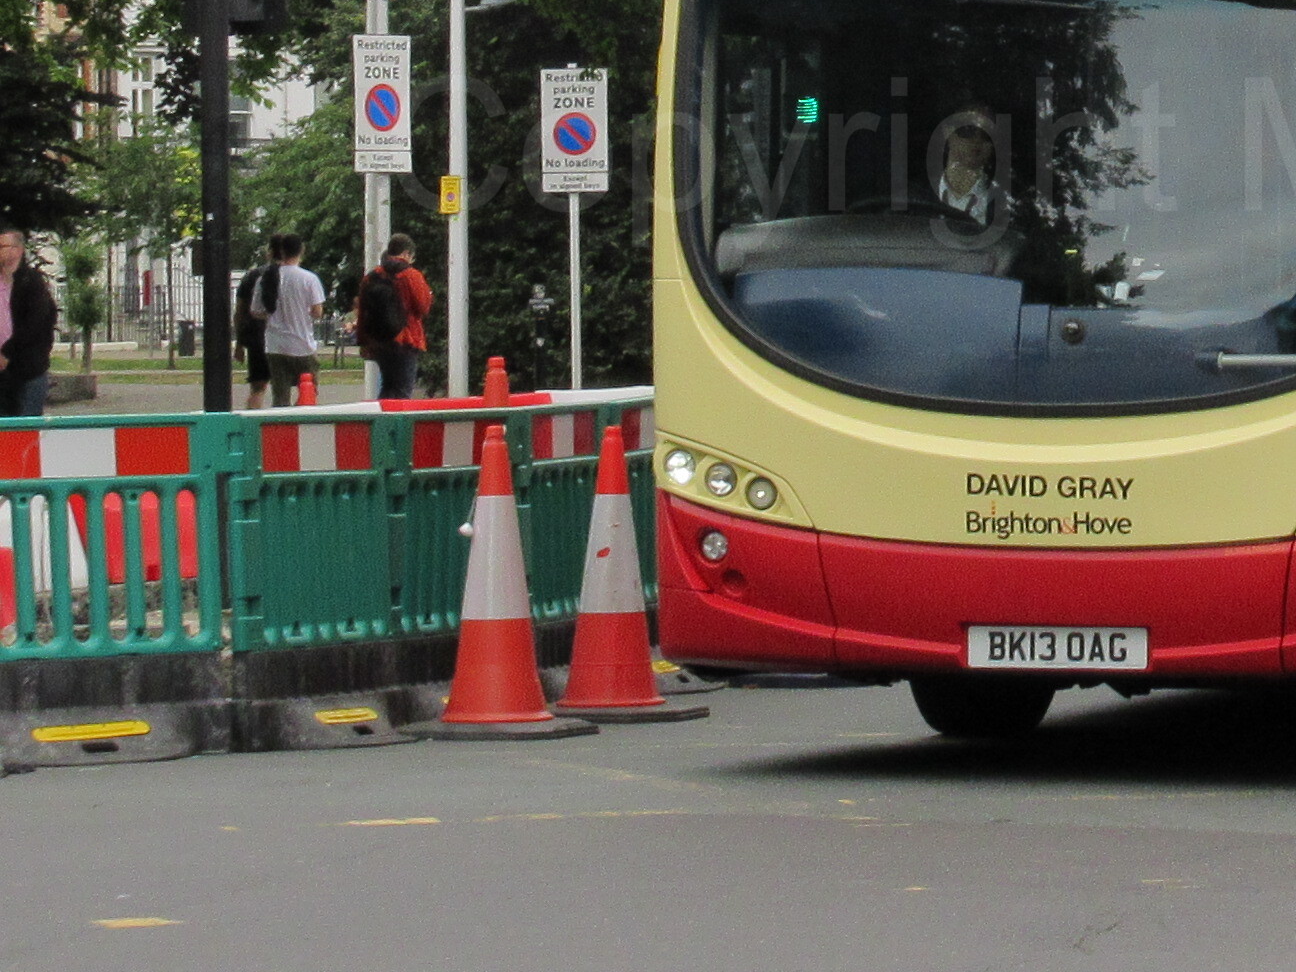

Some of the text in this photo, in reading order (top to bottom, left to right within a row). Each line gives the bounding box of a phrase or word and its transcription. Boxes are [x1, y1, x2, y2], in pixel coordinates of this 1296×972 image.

[357, 39, 407, 51] Restricted
[364, 54, 400, 64] parking
[364, 67, 400, 79] ZONE
[545, 73, 604, 83] Restrid
[553, 84, 596, 95] parking
[553, 97, 595, 108] ZONE
[357, 135, 409, 147] No loading
[545, 158, 605, 168] No loading
[966, 473, 1135, 500] DAVID GRAY
[965, 507, 1133, 540] Brighton&Hove
[988, 631, 1128, 662] BK13 OAG
